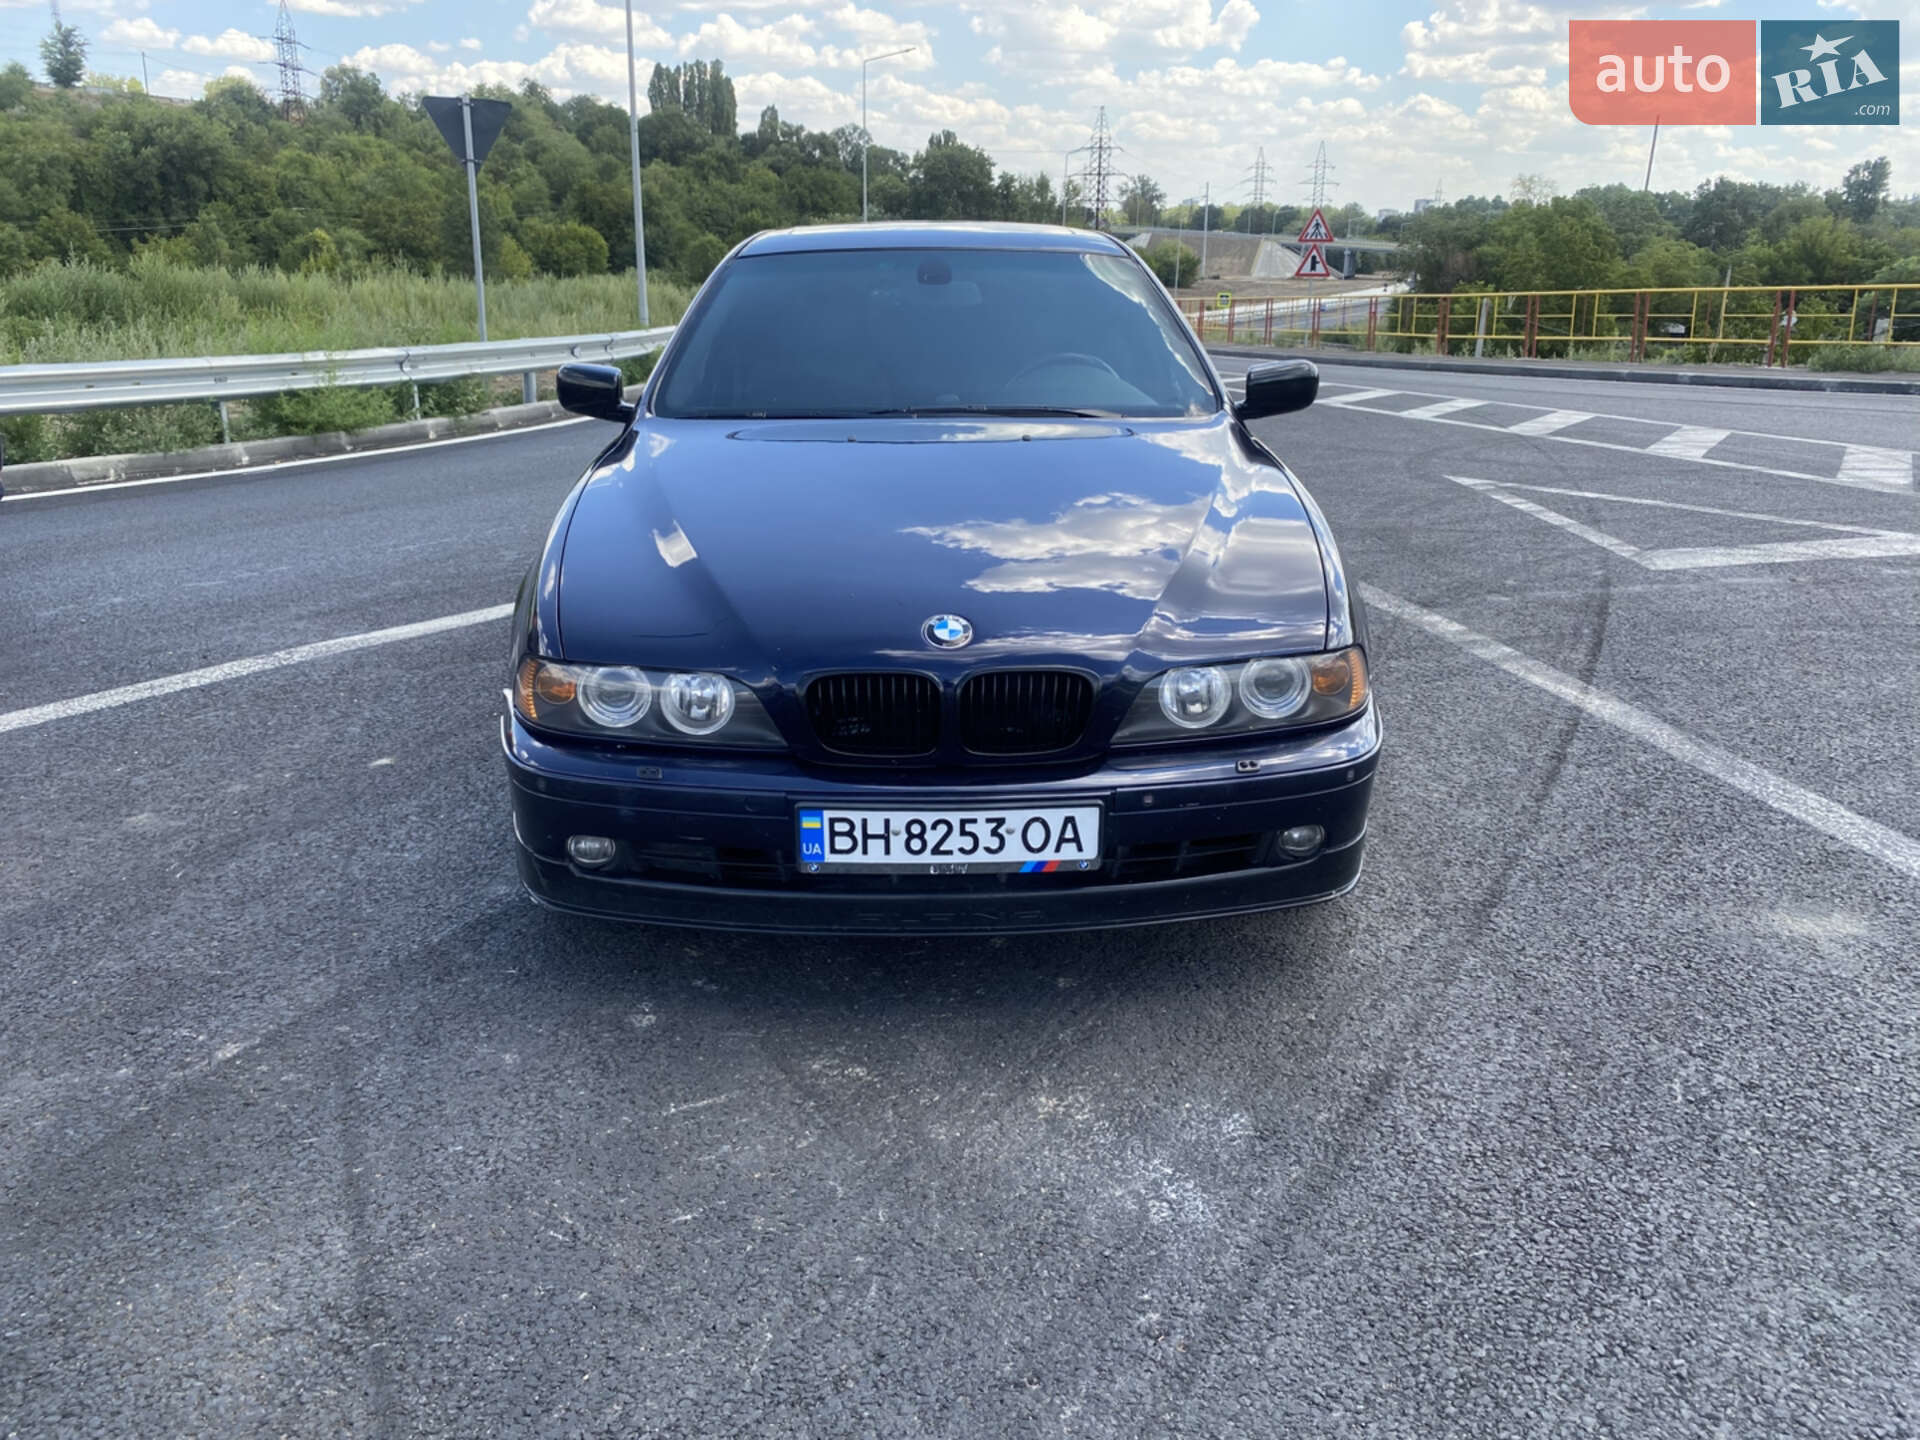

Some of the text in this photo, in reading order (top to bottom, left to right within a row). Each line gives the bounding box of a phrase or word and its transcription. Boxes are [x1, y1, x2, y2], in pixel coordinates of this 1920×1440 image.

[828, 815, 1084, 855] BH 8253 OA
[803, 842, 822, 855] UA
